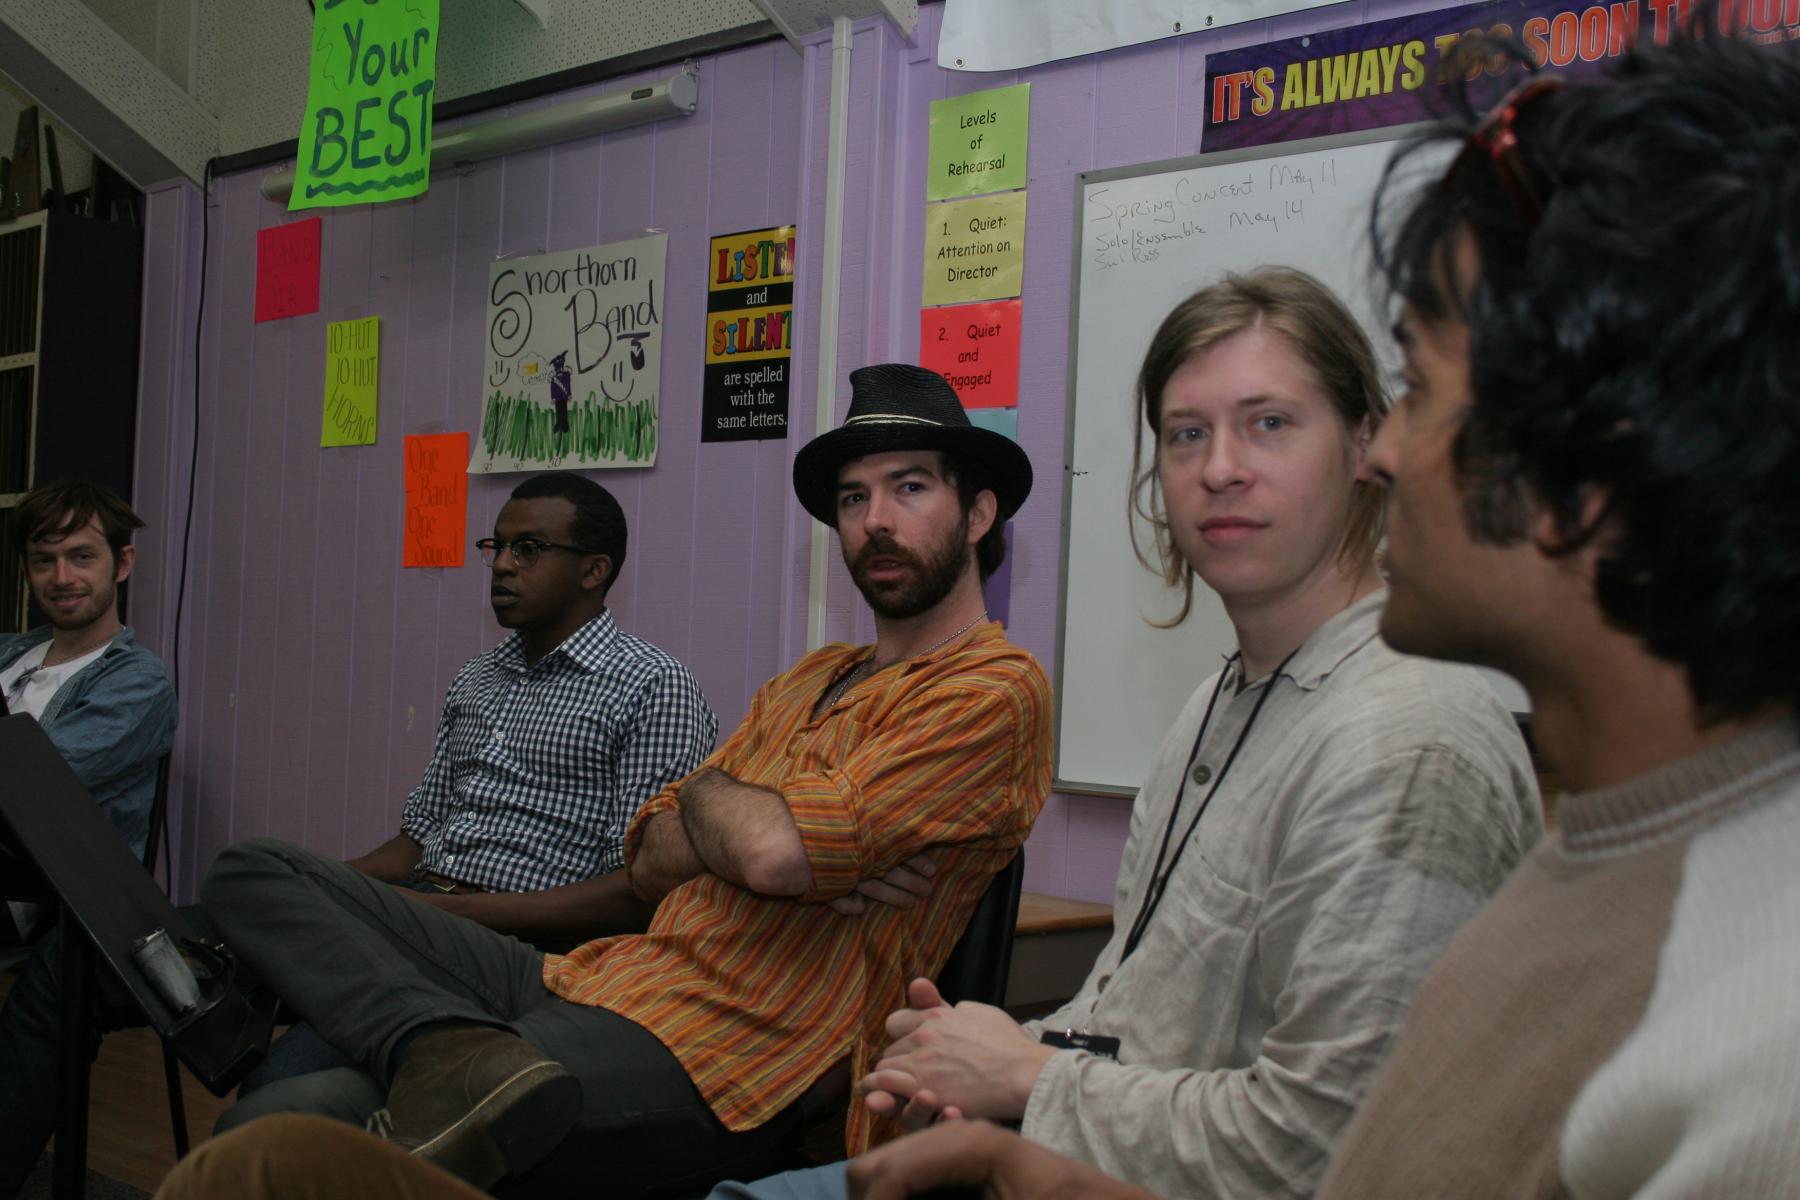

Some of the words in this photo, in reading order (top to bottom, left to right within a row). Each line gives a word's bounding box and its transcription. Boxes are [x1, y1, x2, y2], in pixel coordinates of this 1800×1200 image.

[343, 18, 430, 86] Your
[1212, 67, 1275, 124] IT'S
[1280, 40, 1426, 111] ALWAYS
[1521, 0, 1640, 72] SOON
[309, 79, 434, 178] BEST
[960, 109, 997, 129] Levels
[970, 134, 983, 149] of
[948, 154, 1006, 177] Rehearsal
[1285, 199, 1304, 224] 14
[943, 222, 951, 236] 1.
[969, 216, 1007, 234] Quiet:
[937, 243, 993, 260] Attention
[996, 241, 1011, 253] on
[947, 265, 998, 282] Director
[746, 287, 768, 305] and
[938, 327, 949, 341] 2.
[967, 323, 1002, 341] Quiet
[958, 347, 979, 363] and
[724, 373, 741, 386] are
[744, 365, 783, 388] spelled
[730, 391, 755, 407] with
[758, 389, 775, 405] the
[717, 416, 746, 429] same
[750, 411, 788, 427] letters.
[409, 439, 440, 473] One
[418, 471, 458, 507] Band
[415, 531, 457, 564] Sound
